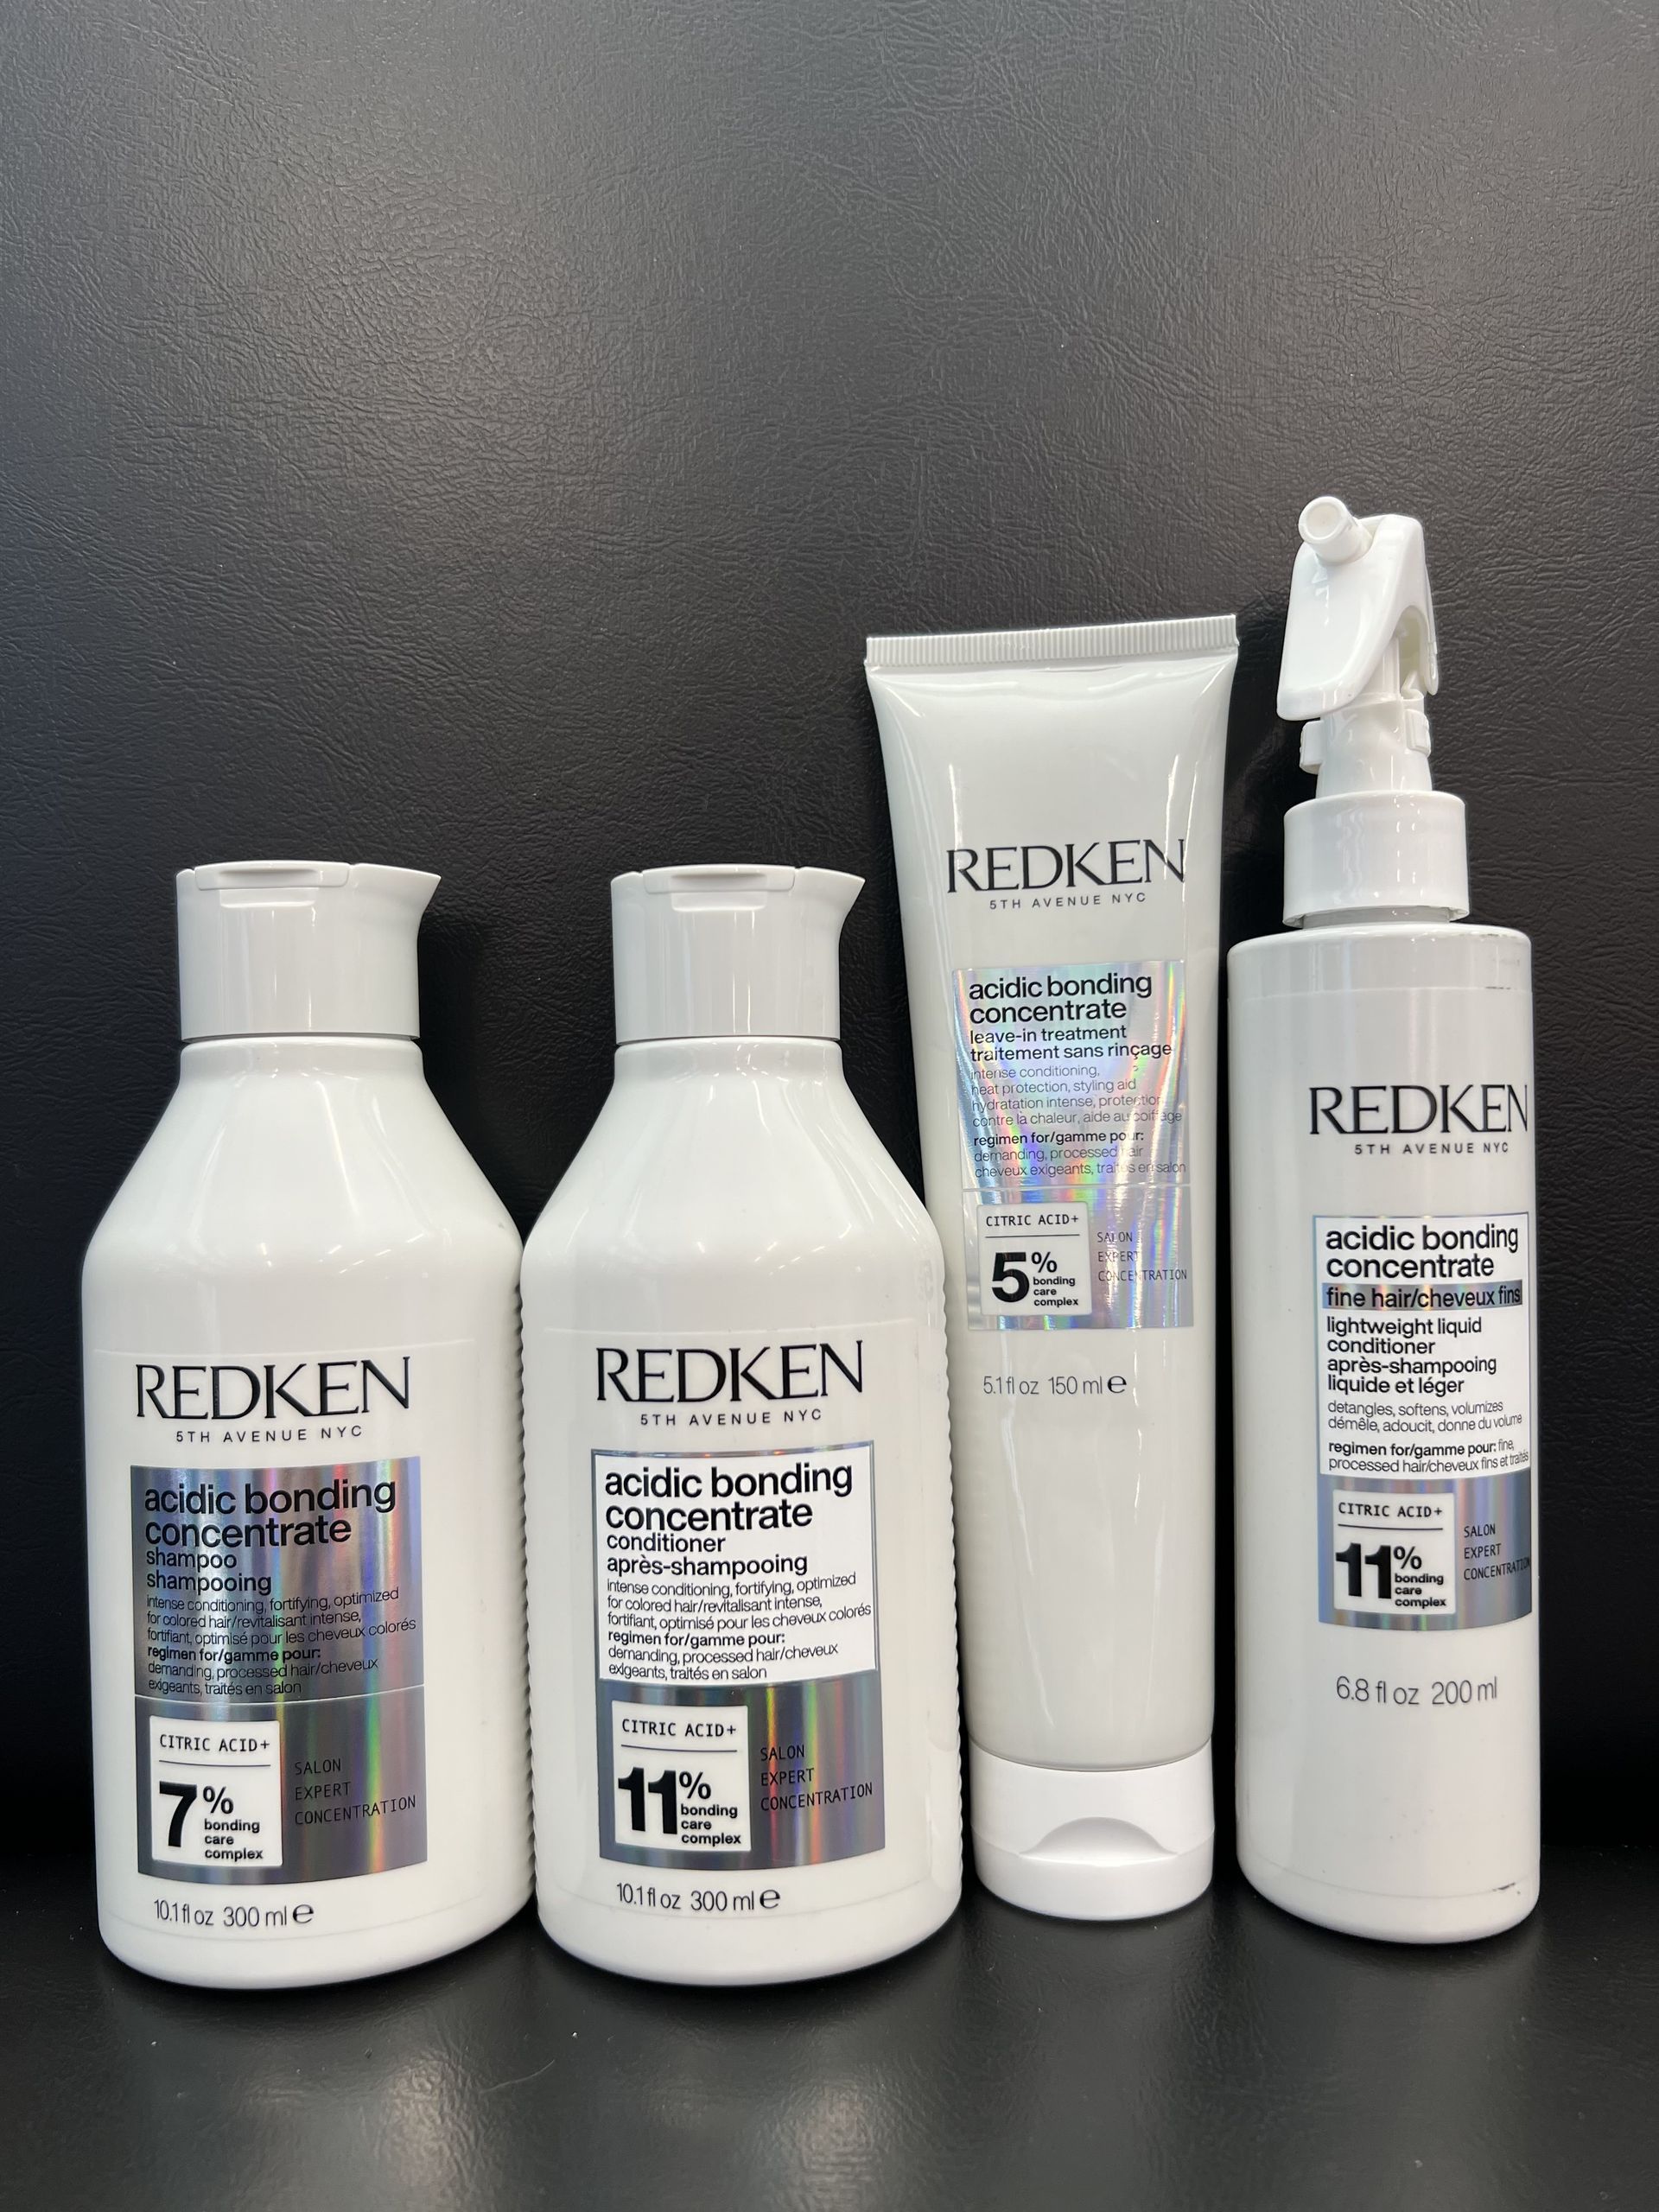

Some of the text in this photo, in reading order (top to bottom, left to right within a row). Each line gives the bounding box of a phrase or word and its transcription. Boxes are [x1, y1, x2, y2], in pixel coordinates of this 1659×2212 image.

[946, 838, 1185, 893] REDKEN
[989, 893, 1147, 910] 5TH AVENUE NYC
[969, 973, 1152, 1000] acidic bonding
[969, 1000, 1127, 1024] concentrate
[969, 1026, 1127, 1044] leave-in treatment
[970, 1043, 1172, 1062] traitement sans rinçage
[970, 1066, 1099, 1079] intense conditioning,
[971, 1079, 1135, 1096] heat protection, styling aid
[1308, 1084, 1528, 1135] REDKEN
[973, 1132, 1106, 1146] regimen for/gamme
[1355, 1142, 1509, 1154] 5TH AVENUE NYC
[986, 1215, 1078, 1227] CITRIC ACID+
[1325, 1224, 1518, 1253] acidic bonding
[1326, 1253, 1494, 1279] concentrate
[992, 1251, 1058, 1303] 5%
[1033, 1277, 1075, 1286] bonding
[1033, 1287, 1056, 1296] care
[1325, 1287, 1521, 1308] fine hair/cheveux fins
[1033, 1298, 1078, 1307] complex
[1326, 1316, 1482, 1338] lightweight liquid
[1327, 1338, 1436, 1355] conditioner
[596, 1339, 863, 1403] REDKEN
[1327, 1357, 1497, 1376] après-shampooing
[136, 1357, 410, 1420] REDKEN
[983, 1376, 1103, 1395] 5.1 fl oz 150 ml
[1328, 1375, 1465, 1397] liquide et léger
[640, 1408, 823, 1426] 5TH AVENUE NYC
[1327, 1400, 1503, 1418] detangles, softens, volumizes
[1328, 1413, 1522, 1433] démêle, adoucit, donne du volume
[176, 1425, 363, 1443] 5TH AVENUE NYC
[1329, 1439, 1515, 1459] regimen for/gamme pour: fine,
[1329, 1455, 1509, 1472] processed hair/cheveux fins et
[605, 1462, 853, 1499] acidic bonding
[144, 1479, 397, 1515] acidic bonding
[605, 1498, 813, 1532] concentrate
[1338, 1502, 1443, 1517] CITRIC ACID+
[145, 1515, 352, 1548] concentrate
[1464, 1523, 1497, 1538] SALON
[607, 1532, 726, 1553] conditioner
[1464, 1543, 1502, 1560] EXPERT
[146, 1547, 237, 1571] shampoo
[607, 1554, 808, 1580] après-shampooing
[1335, 1542, 1422, 1599] 11%
[1395, 1573, 1444, 1585] bonding
[146, 1571, 271, 1595] shampooing
[607, 1572, 856, 1599] intense conditioning, fortifying, optimized
[1395, 1586, 1422, 1595] care
[607, 1595, 823, 1614] for colored hair/revitalisant intense,
[1395, 1597, 1446, 1609] complex
[607, 1604, 872, 1632] fortifiant, optimisé pour les cheveux colorés
[607, 1630, 786, 1648] regimen for/gamme pour:
[148, 1645, 321, 1663] regimen for/gamme pour:
[608, 1643, 839, 1666] demanding, processed hair/cheveux
[608, 1664, 767, 1681] exigeants, traités en salon
[1336, 1675, 1497, 1705] 6.8 fl oz 200 ml
[622, 1719, 737, 1738] CITRIC ACID+
[159, 1734, 270, 1752] CITRIC ACID+
[760, 1744, 805, 1762] SALON
[295, 1758, 341, 1776] SALON
[760, 1768, 815, 1787] EXPERT
[295, 1781, 351, 1801] EXPERT
[618, 1766, 712, 1835] 11%
[760, 1781, 874, 1811] CONCENTRATION
[159, 1780, 234, 1848] 7%
[295, 1794, 416, 1825] CONCENTRATION
[680, 1803, 738, 1819] bonding
[204, 1819, 260, 1834] bonding
[681, 1819, 712, 1831] care
[205, 1834, 234, 1846] care
[681, 1832, 741, 1847] complex
[205, 1848, 263, 1862] complex
[616, 1883, 754, 1911] 10.1 fl oz 300 ml
[154, 1899, 288, 1927] 10.1 fl oz 300 ml
